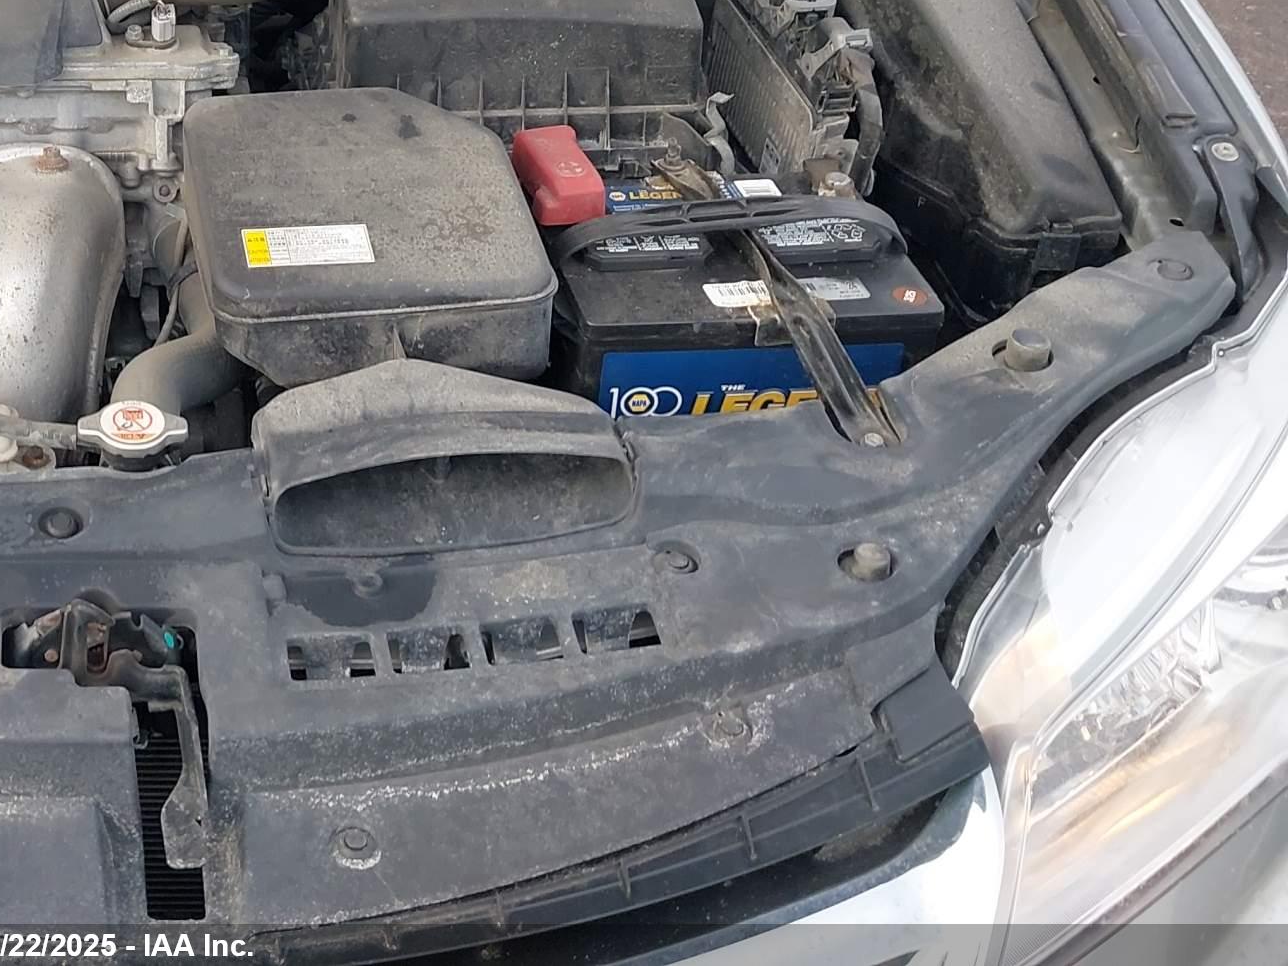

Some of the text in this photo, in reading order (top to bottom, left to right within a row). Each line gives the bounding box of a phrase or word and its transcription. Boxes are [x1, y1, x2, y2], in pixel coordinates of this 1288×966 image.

[629, 190, 682, 201] LEGEN
[721, 384, 746, 392] THE
[609, 386, 683, 419] 100
[631, 399, 647, 408] NAPA
